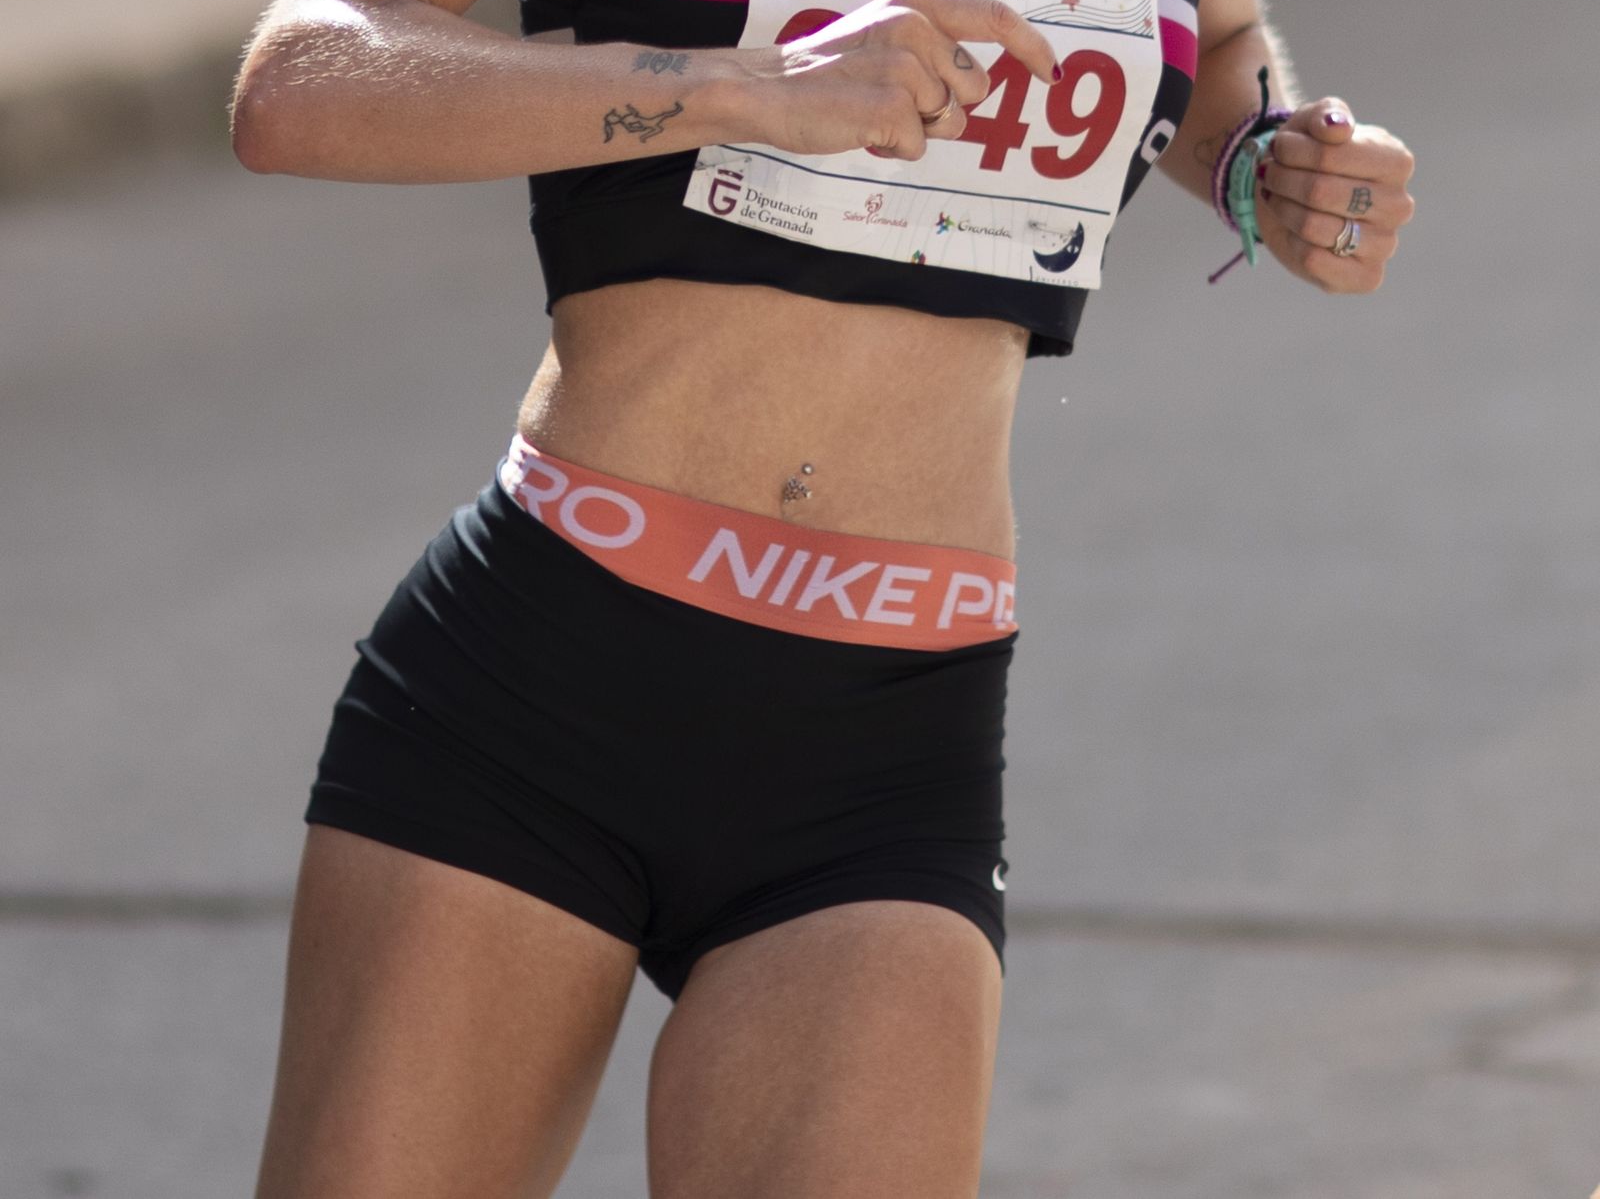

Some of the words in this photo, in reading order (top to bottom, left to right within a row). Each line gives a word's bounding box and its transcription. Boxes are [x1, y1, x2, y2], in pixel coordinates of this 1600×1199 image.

[740, 205, 757, 220] de
[758, 209, 814, 236] Granada
[745, 188, 818, 221] Diputación
[958, 218, 1012, 239] Granada
[687, 527, 931, 626] NIKE
